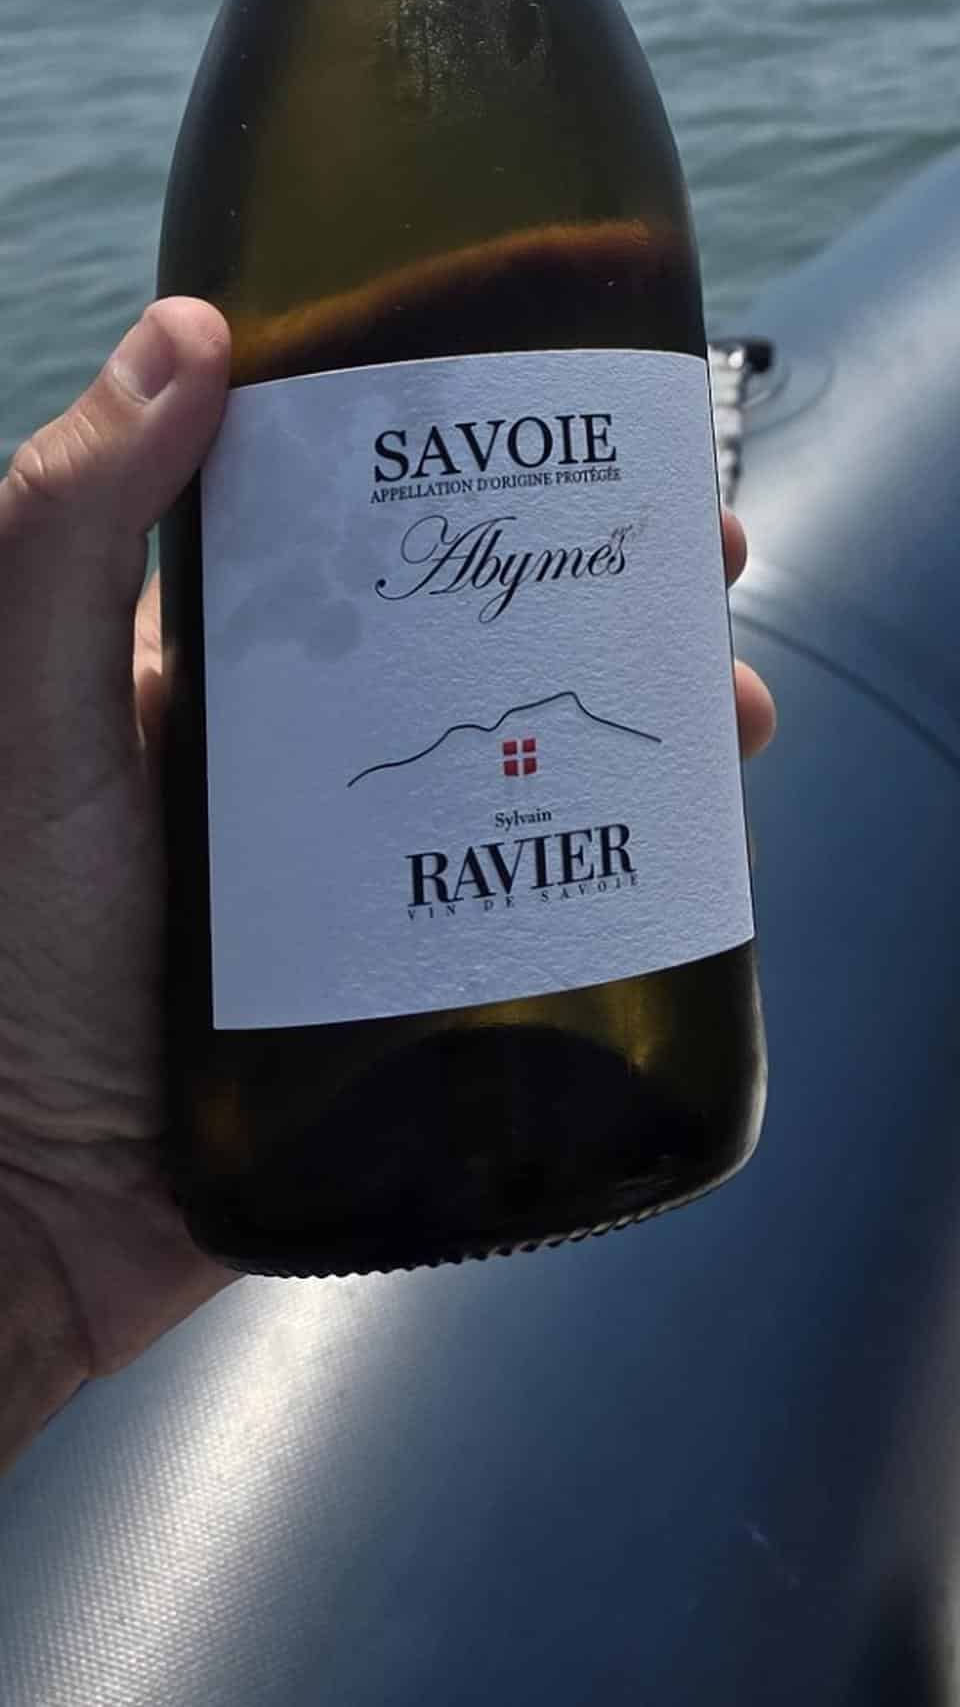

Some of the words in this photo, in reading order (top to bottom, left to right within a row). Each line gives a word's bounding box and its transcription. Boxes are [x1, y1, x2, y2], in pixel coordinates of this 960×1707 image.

[374, 413, 617, 483] SAVOIE
[370, 478, 474, 504] APPELLATION
[477, 471, 552, 492] D'ORIGINE
[555, 464, 622, 485] PROTÉGÉE
[374, 514, 626, 624] Abymes
[495, 808, 553, 833] Sylvain
[404, 823, 637, 907] RAVIER
[407, 905, 456, 921] VIN
[483, 896, 516, 911] DE
[541, 875, 641, 903] SAVOIE
